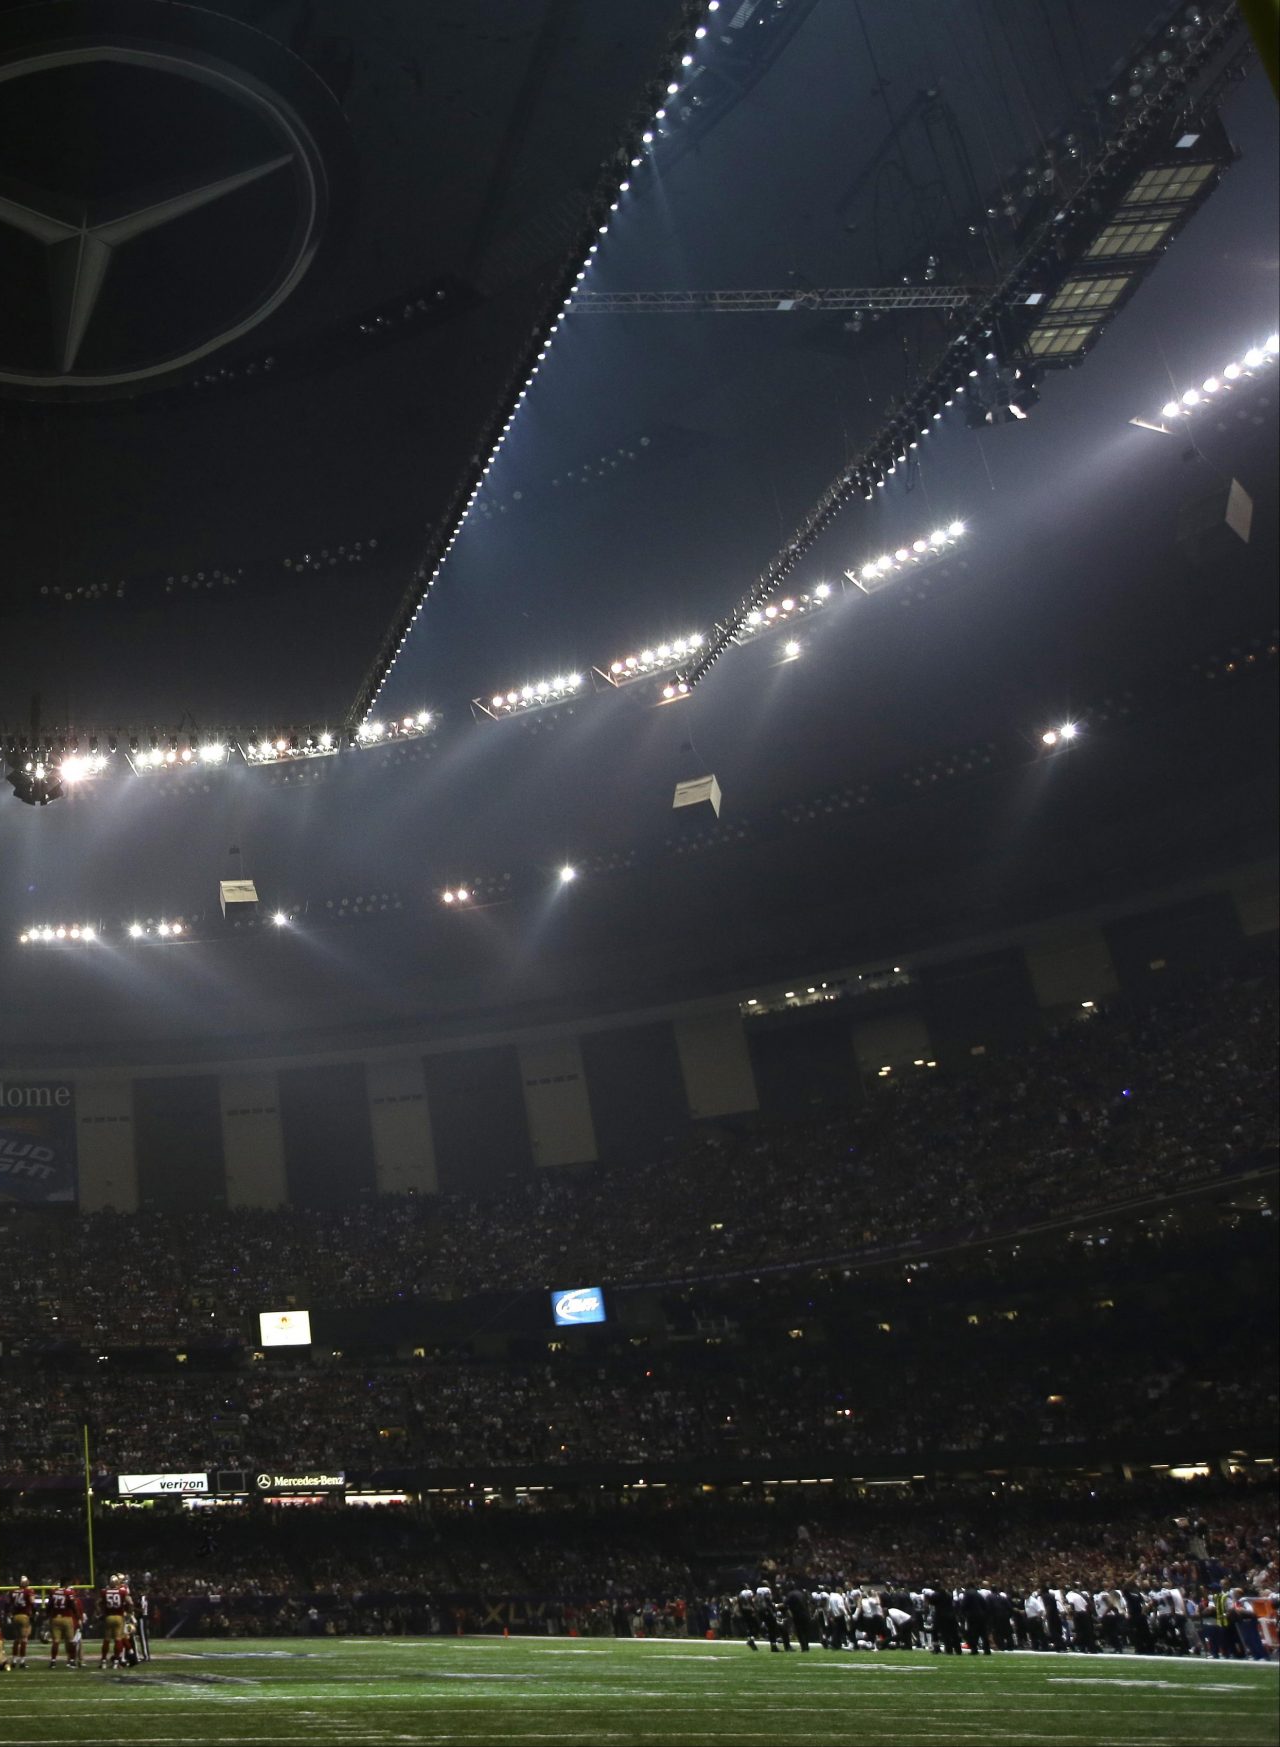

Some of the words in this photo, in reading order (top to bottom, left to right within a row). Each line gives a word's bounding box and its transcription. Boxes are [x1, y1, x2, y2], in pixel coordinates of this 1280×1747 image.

[160, 1478, 204, 1490] verizon
[274, 1475, 344, 1487] Mercedes-Benz
[106, 1593, 121, 1608] 59
